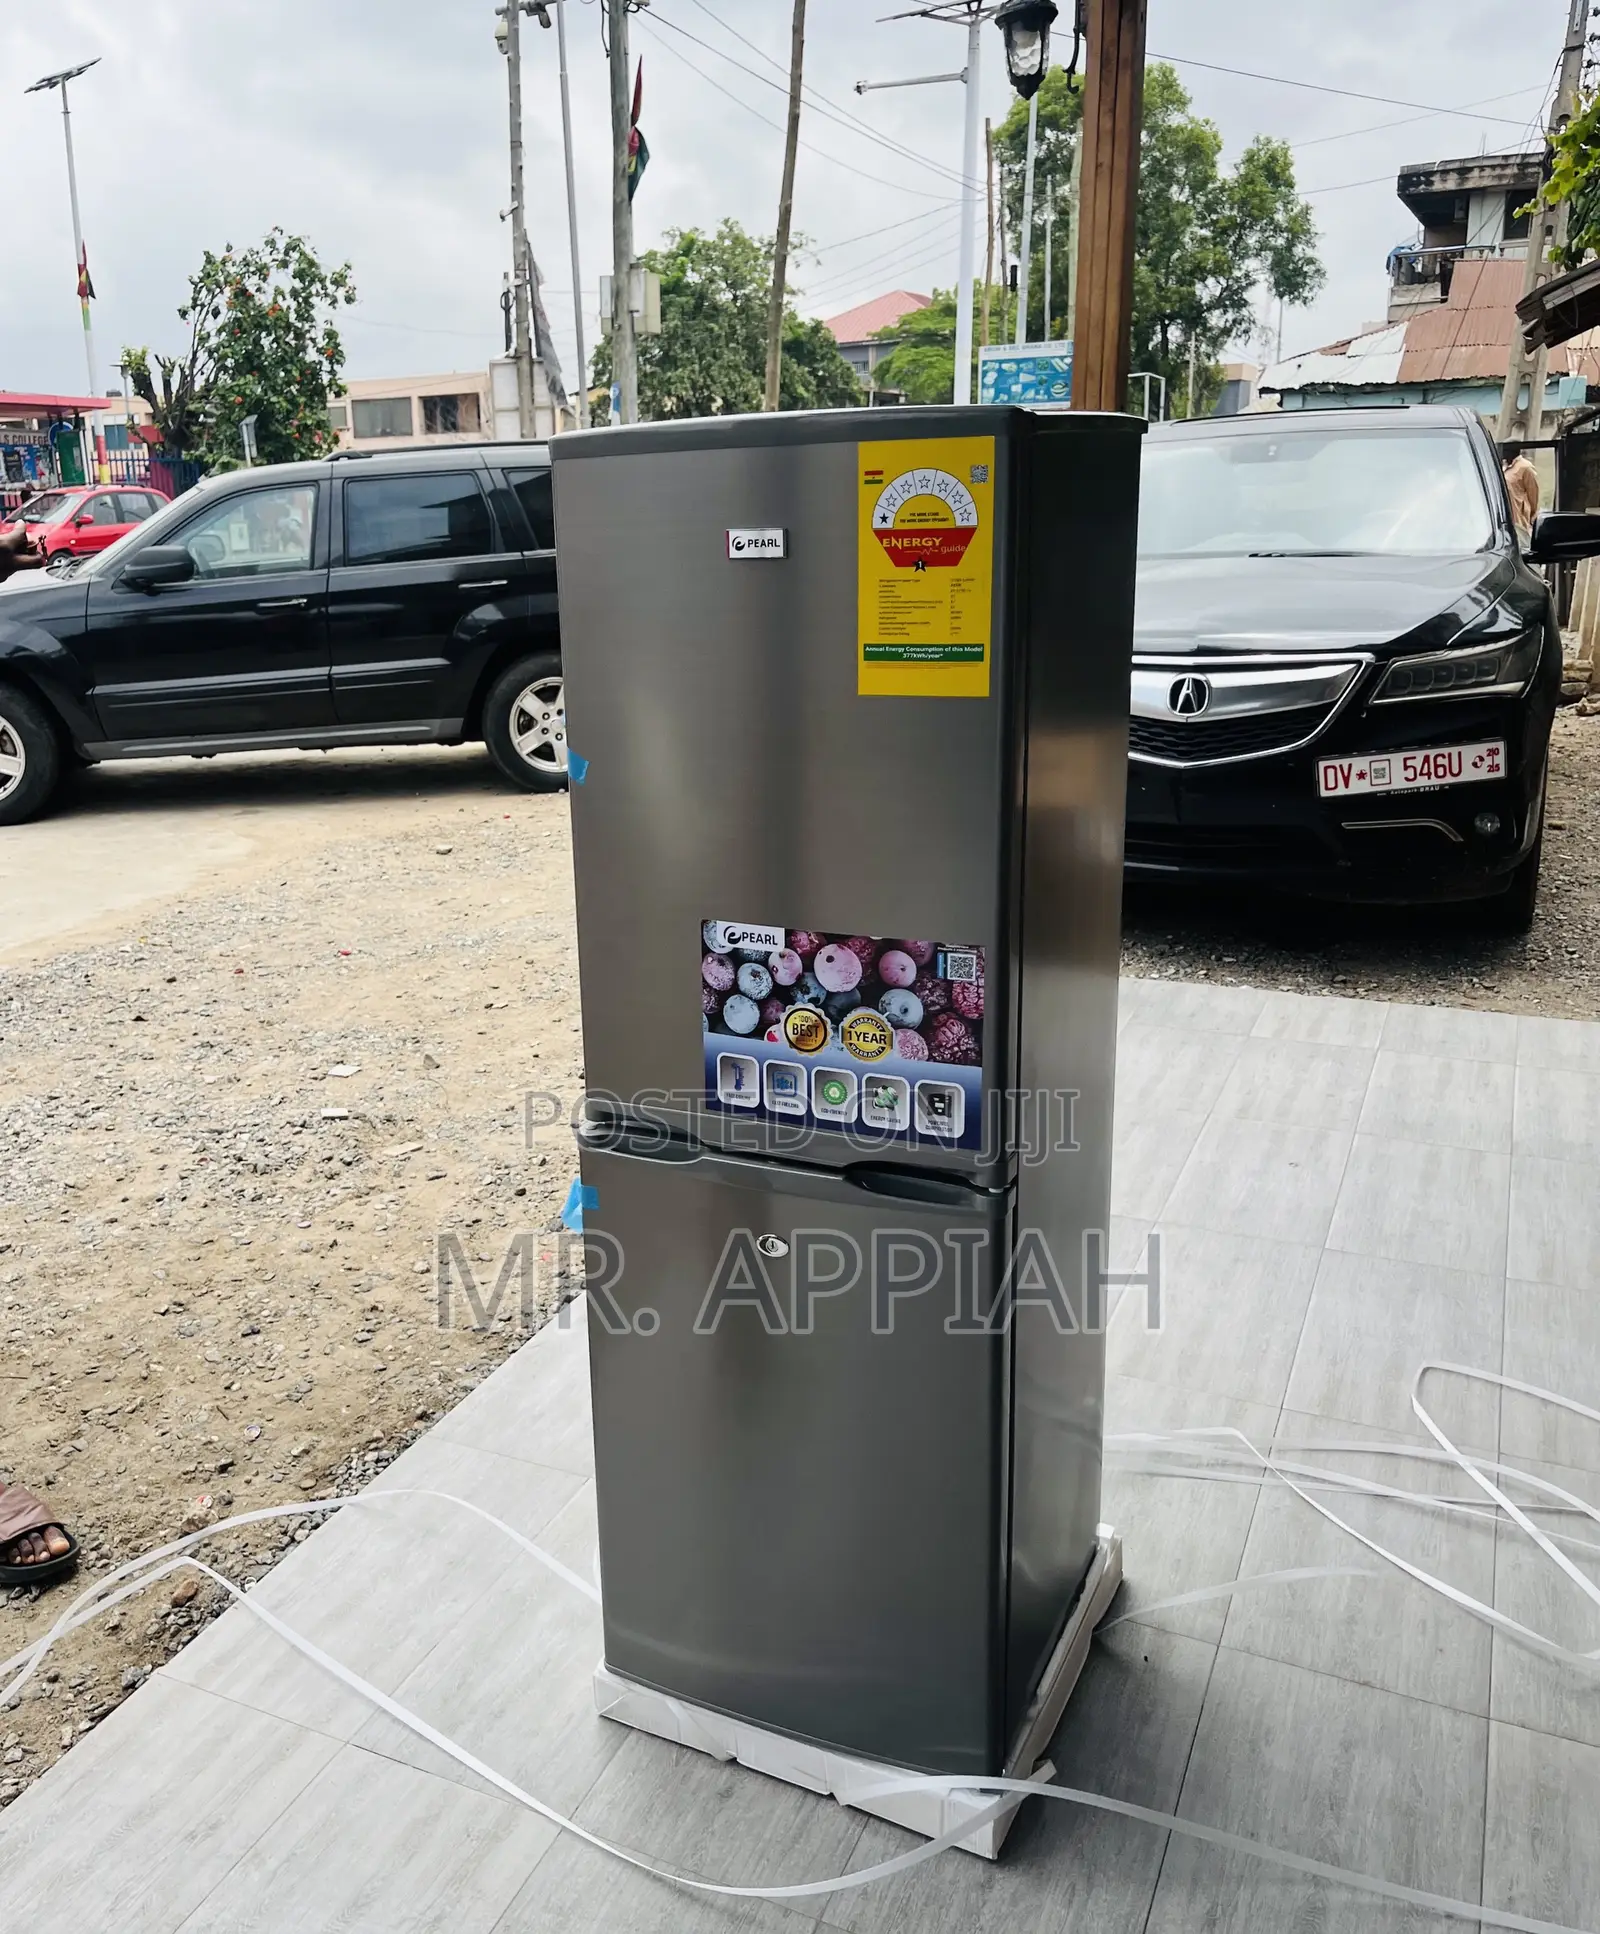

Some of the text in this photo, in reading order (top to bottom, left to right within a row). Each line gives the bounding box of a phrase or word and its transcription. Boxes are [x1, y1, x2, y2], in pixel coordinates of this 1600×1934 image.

[747, 538, 781, 548] PEARL
[882, 536, 944, 550] ENERGY
[940, 545, 967, 555] guide
[1402, 750, 1463, 783] 546U
[741, 931, 779, 946] PEARL
[792, 1023, 821, 1039] BEST
[849, 1017, 885, 1032] WARRANTY
[854, 1031, 888, 1046] YEAR
[850, 1043, 884, 1058] WARRANTY
